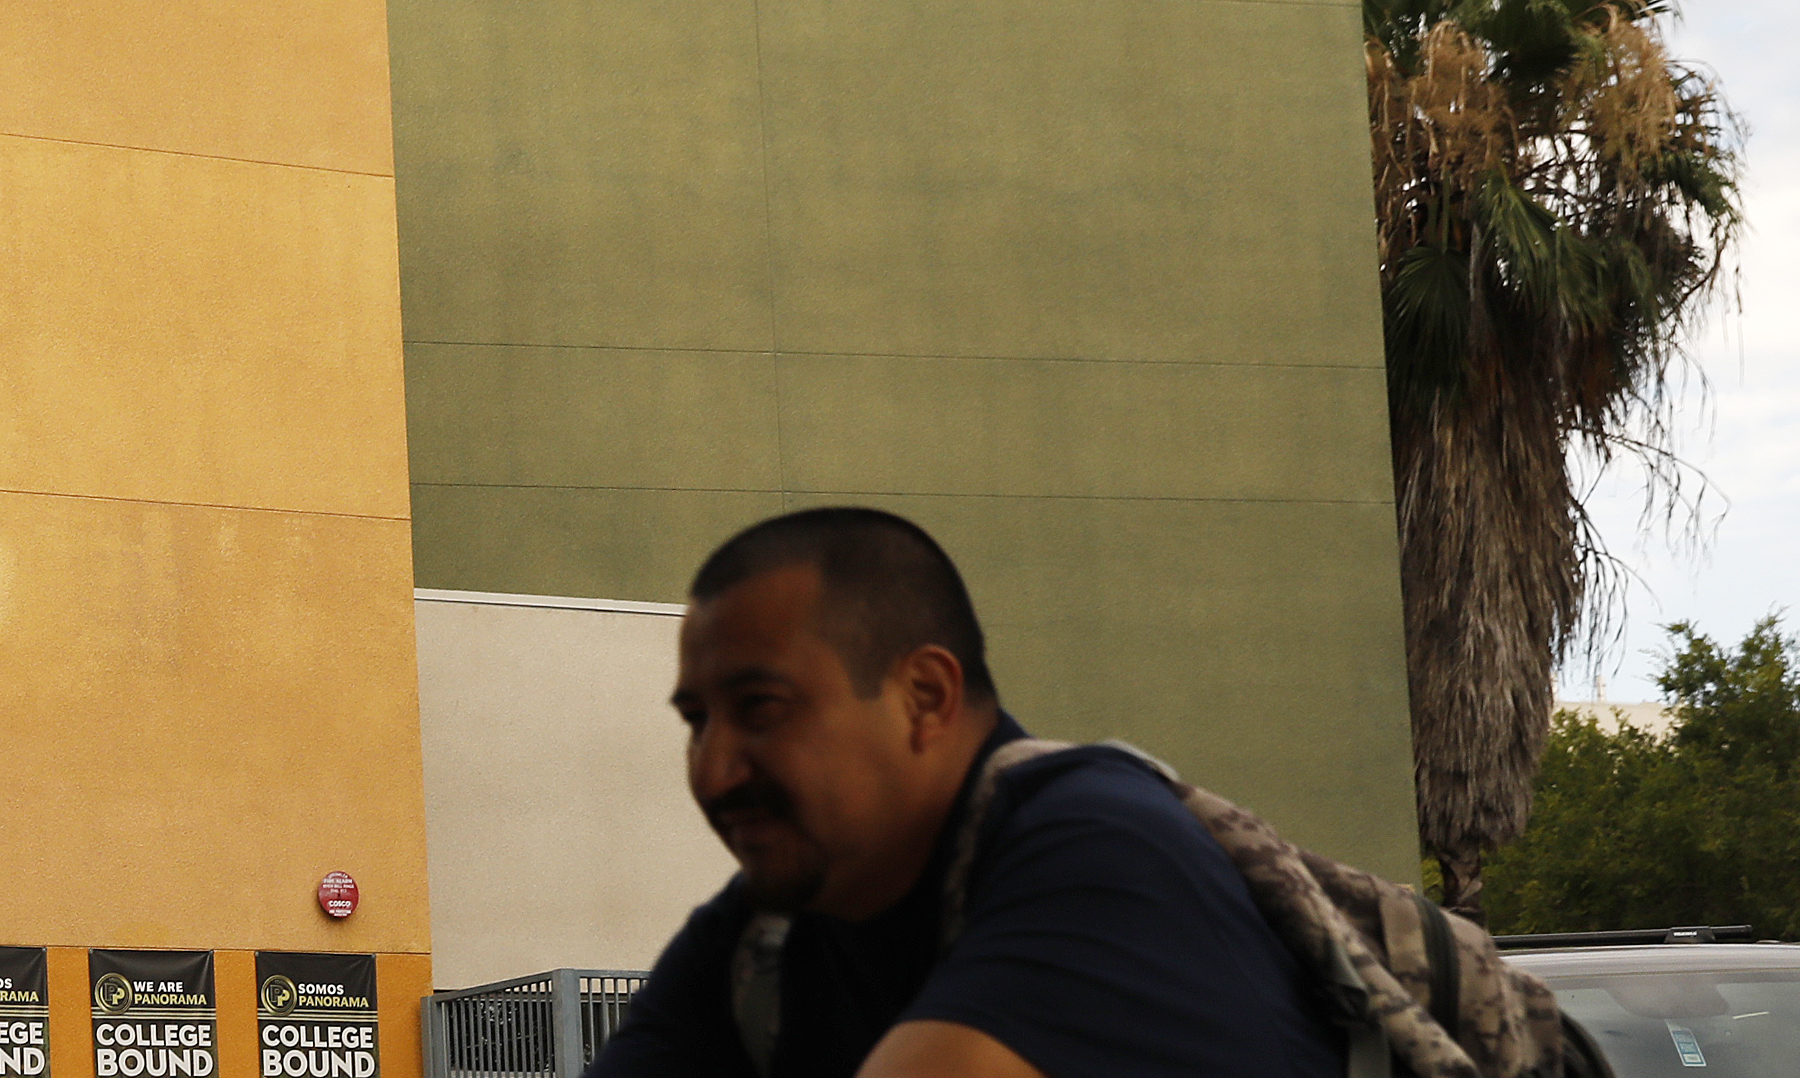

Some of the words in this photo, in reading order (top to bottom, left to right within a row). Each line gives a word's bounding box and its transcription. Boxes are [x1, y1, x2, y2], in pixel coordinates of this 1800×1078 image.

[133, 981, 154, 993] WE
[157, 982, 183, 993] ARE
[298, 983, 344, 995] SOMOS
[134, 994, 207, 1005] PANORAMA
[298, 996, 369, 1008] PANORAMA
[96, 1023, 212, 1047] COLLEGE
[262, 1024, 374, 1049] COLLEGE
[97, 1049, 213, 1077] BOUND
[263, 1050, 375, 1078] BOUND
